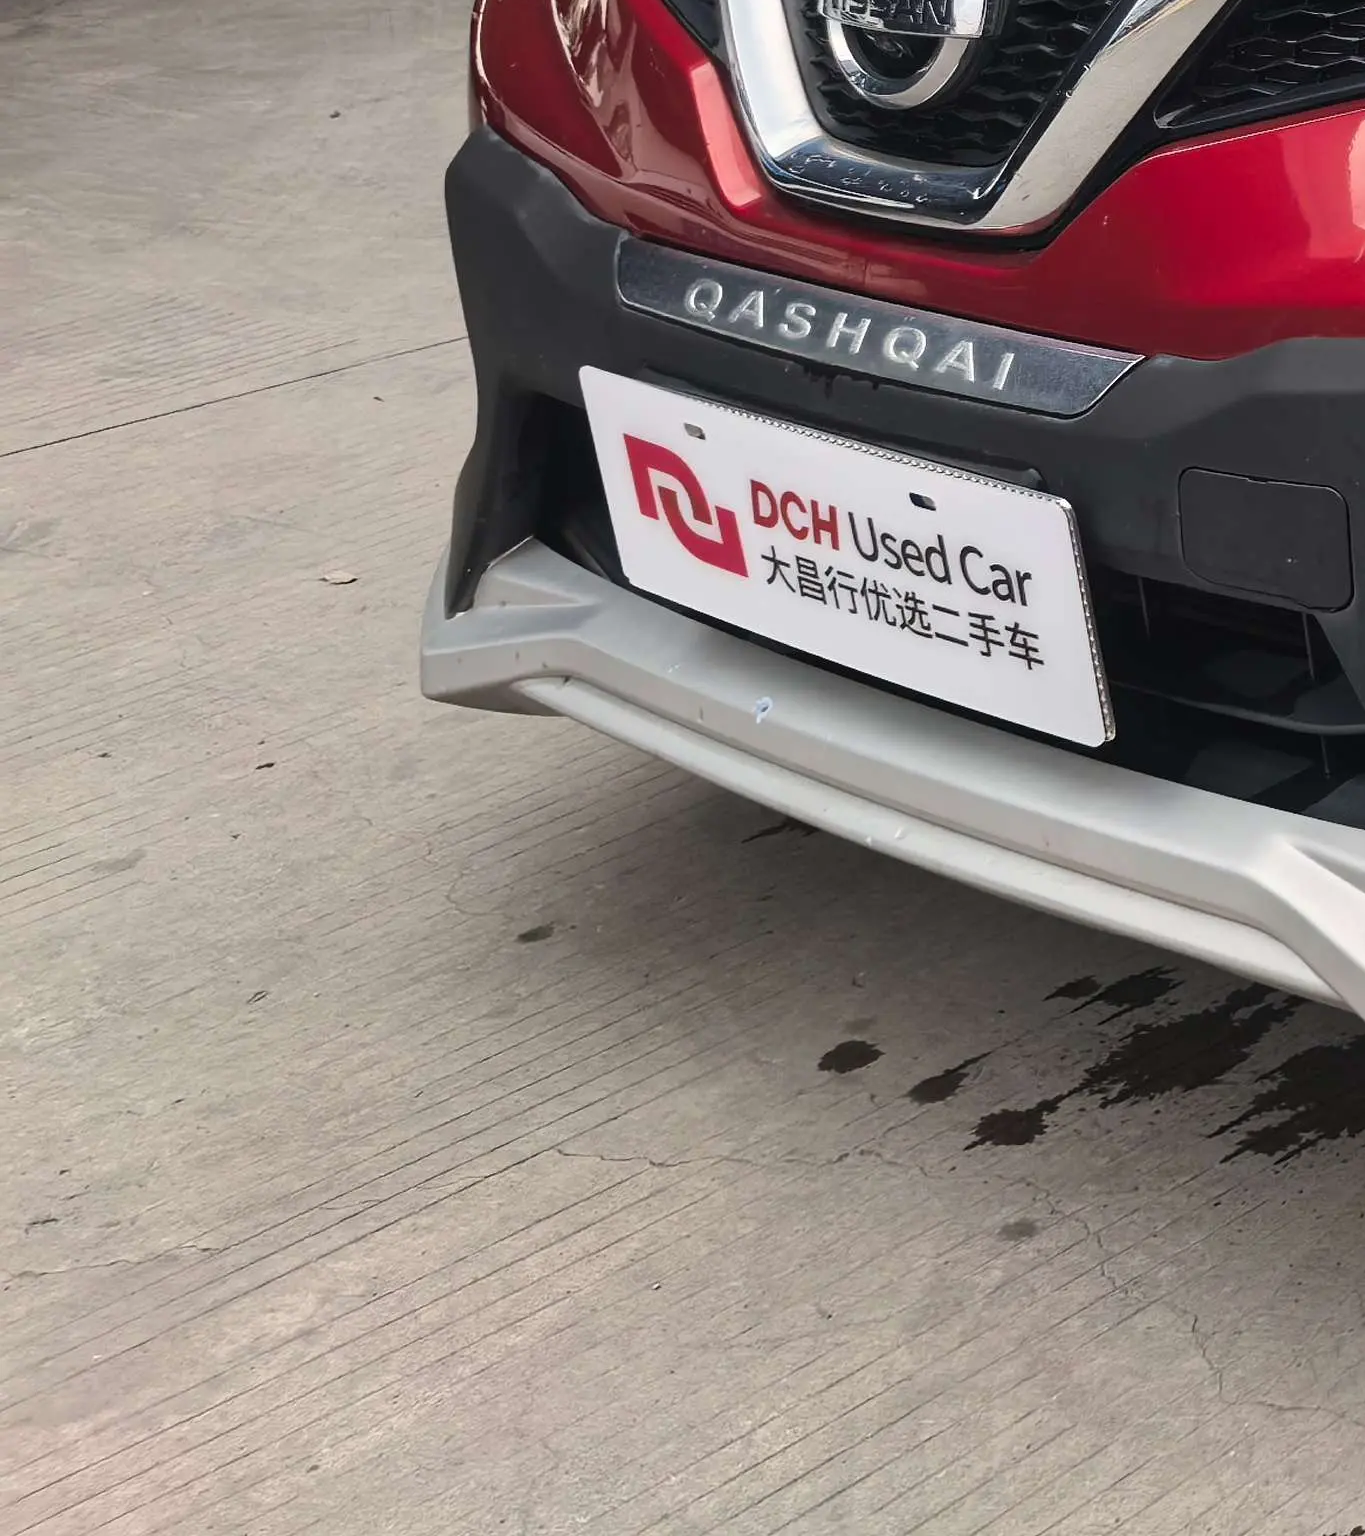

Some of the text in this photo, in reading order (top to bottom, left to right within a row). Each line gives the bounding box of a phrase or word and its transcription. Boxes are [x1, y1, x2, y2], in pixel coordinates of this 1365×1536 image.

[683, 277, 1017, 392] QASHQAI
[749, 479, 1033, 607] DCH Used Car
[760, 544, 1046, 672] 大昌行优选二手车
